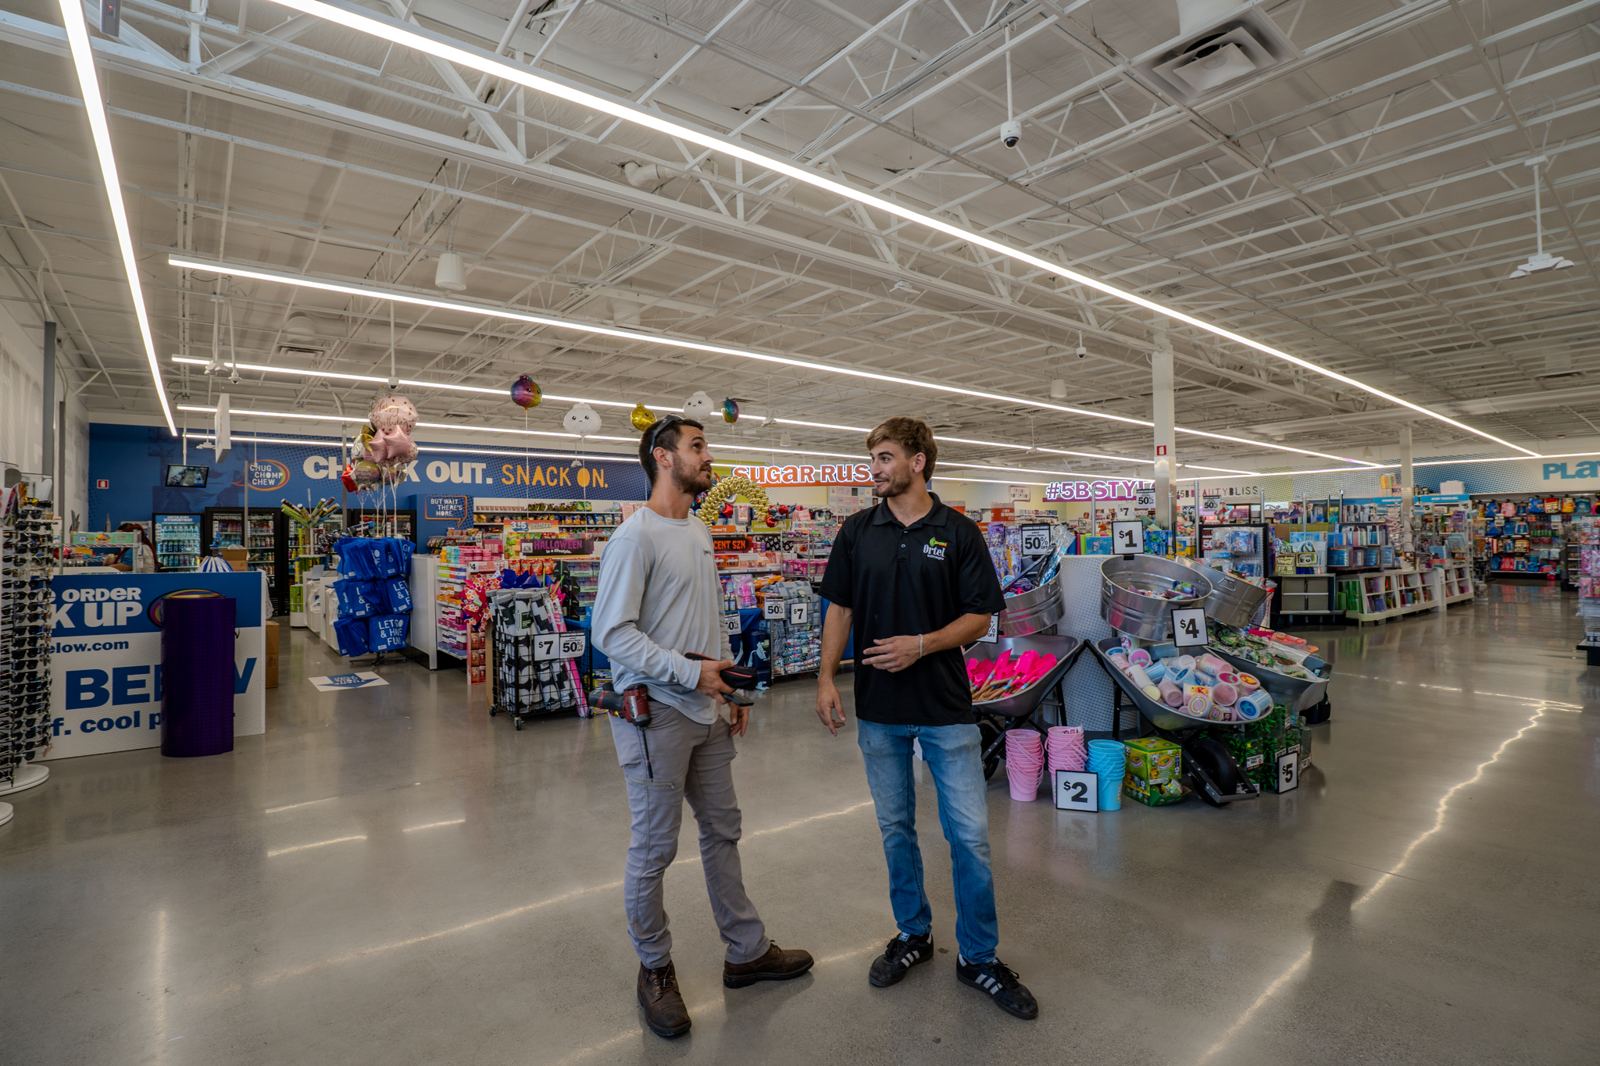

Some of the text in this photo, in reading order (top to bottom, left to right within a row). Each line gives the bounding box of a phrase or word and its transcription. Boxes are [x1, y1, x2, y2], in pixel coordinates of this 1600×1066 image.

[255, 471, 284, 479] CHOMP
[303, 455, 420, 482] CHK
[501, 463, 571, 487] SNACK
[577, 467, 609, 488] ON.
[820, 463, 873, 483] RUS
[533, 540, 583, 550] HALLOWEEN
[1118, 529, 1138, 548] $1
[793, 608, 804, 620] $7
[1179, 618, 1200, 639] $4
[538, 640, 554, 655] $7
[80, 710, 140, 734] cool
[1282, 763, 1294, 783] $5
[1063, 780, 1088, 804] $2
